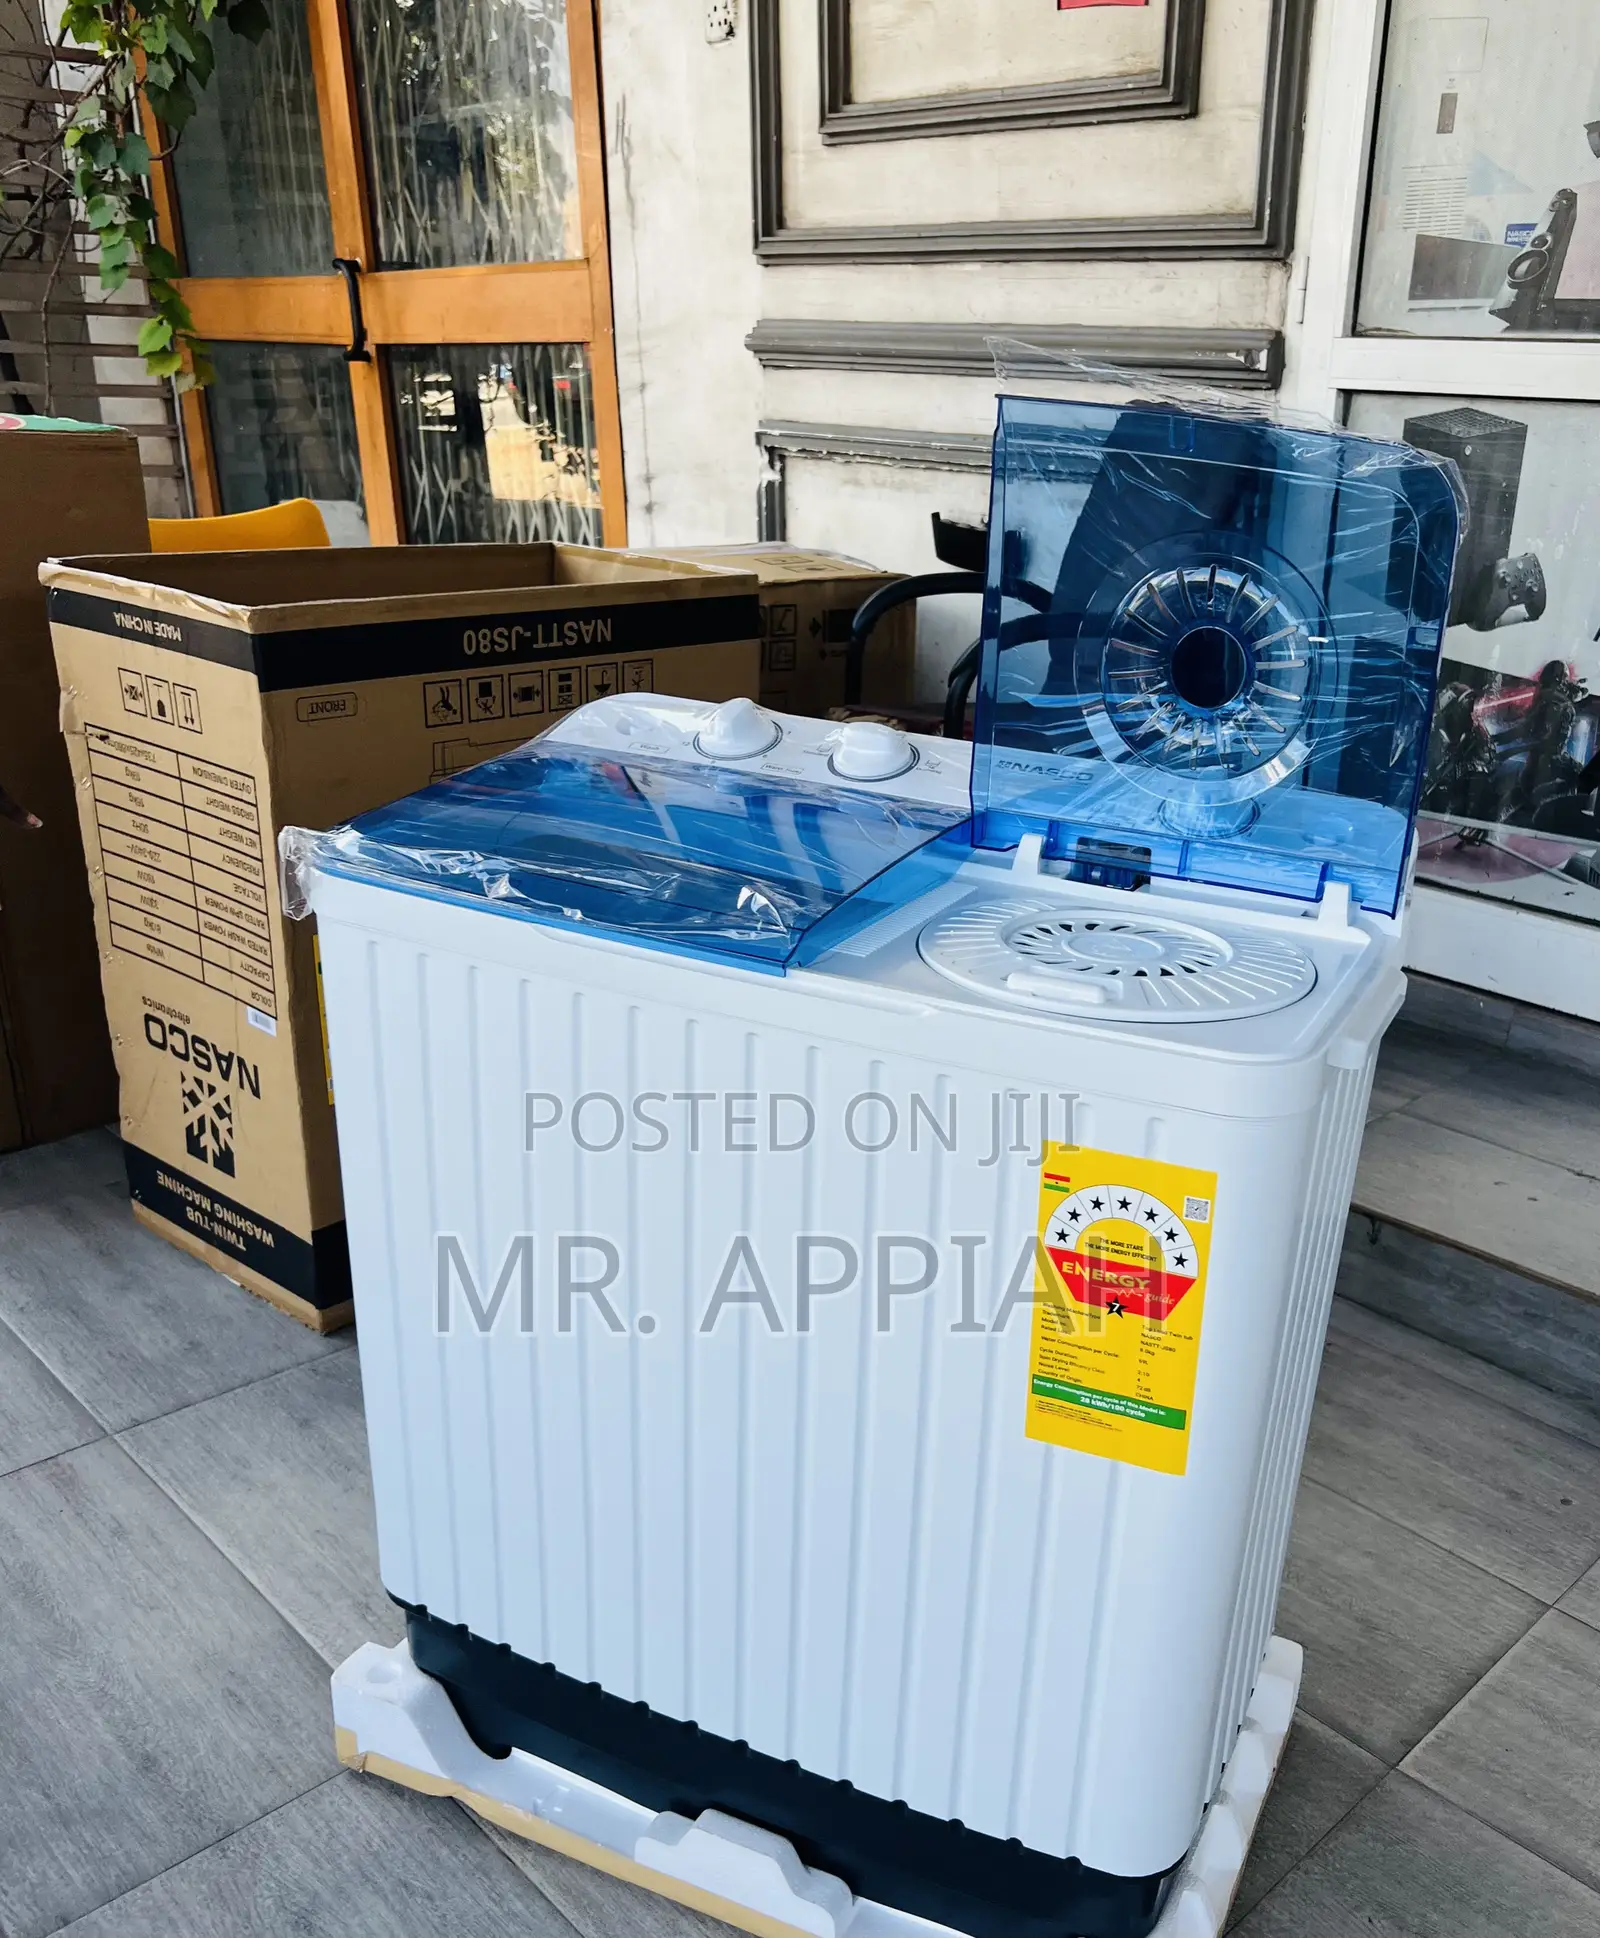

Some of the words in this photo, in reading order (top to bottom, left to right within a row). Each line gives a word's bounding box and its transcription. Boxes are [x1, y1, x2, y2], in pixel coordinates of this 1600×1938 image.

[113, 612, 144, 632] CHINA
[143, 619, 154, 635] IN
[154, 621, 182, 641] MADE
[463, 618, 612, 656] NASTT-JS80
[309, 699, 346, 715] FRONT
[191, 764, 228, 786] DIMENSION
[228, 777, 252, 795] OUTER
[204, 794, 231, 813] WEIGHT
[231, 804, 254, 822] GROSS
[131, 818, 148, 835] 50Hz
[218, 825, 244, 844] WEIGHT
[245, 835, 257, 850] NET
[221, 852, 260, 877] FREQUENCY
[232, 881, 262, 903] VOLTAGE
[204, 895, 228, 913] POWER
[228, 905, 243, 920] SPIN
[203, 918, 226, 937] POWER
[244, 912, 265, 930] RATED
[227, 929, 246, 945] WASH
[247, 938, 267, 956] RATED
[239, 959, 270, 983] CAPACITY
[251, 991, 273, 1007] COLOR
[142, 996, 190, 1024] electronics
[144, 1013, 261, 1100] NASCO
[157, 1170, 212, 1213] MACHINE
[186, 1206, 246, 1251] TWIN-TUB
[214, 1203, 275, 1248] WASHING
[1095, 1244, 1110, 1253] MORE
[1110, 1247, 1131, 1257] ENERGY
[1132, 1251, 1157, 1262] EFFICIENT
[1110, 1240, 1124, 1248] MORE
[1126, 1243, 1143, 1251] STARS
[1062, 1260, 1151, 1290] ENERGY
[1112, 1302, 1120, 1311] 7
[1144, 1293, 1175, 1305] guide
[1033, 1378, 1053, 1388] Energy
[1054, 1383, 1091, 1397] Consumption
[1103, 1395, 1119, 1404] cycle
[1125, 1407, 1145, 1418] cycle
